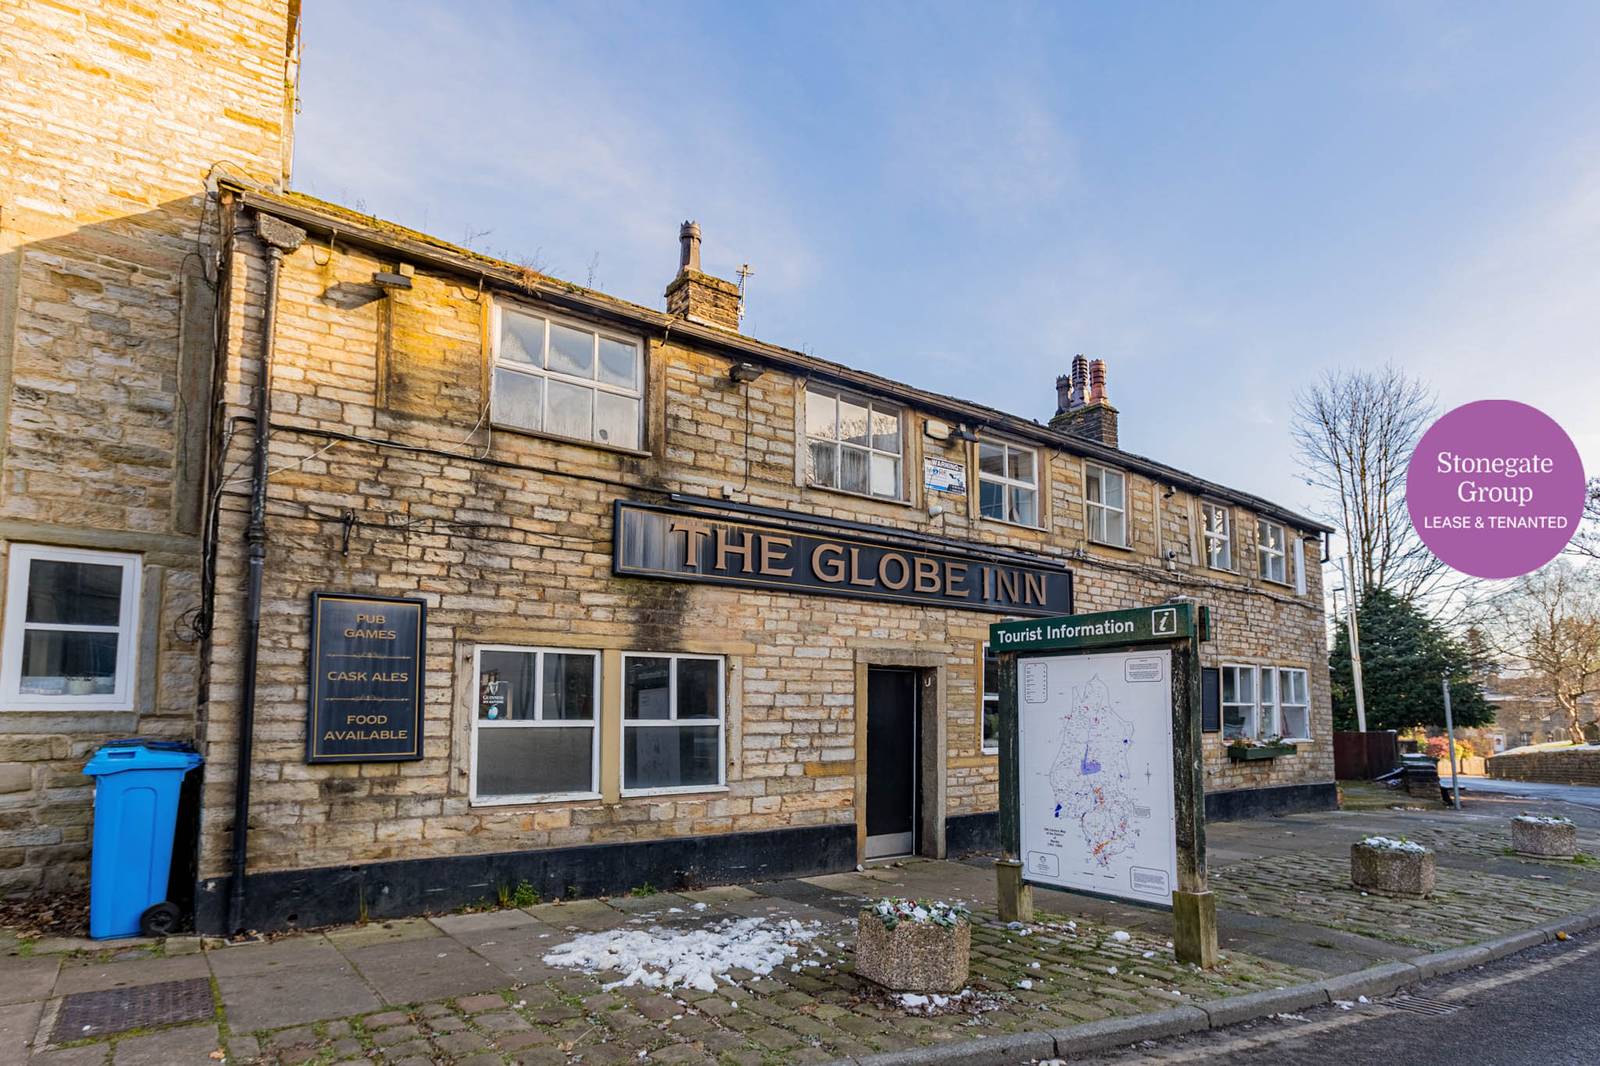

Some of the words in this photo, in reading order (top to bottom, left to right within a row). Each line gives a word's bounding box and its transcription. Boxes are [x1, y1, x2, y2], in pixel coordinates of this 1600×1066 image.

[670, 521, 794, 577] THE
[810, 542, 970, 597] GLOBE
[982, 565, 1048, 606] INN
[356, 614, 386, 624] PUB
[344, 629, 397, 640] GAMES
[997, 628, 1043, 644] Tourist
[1047, 620, 1135, 640] Information
[327, 671, 368, 682] CASK
[371, 672, 409, 682] ALES
[346, 714, 388, 725] FOOD
[323, 730, 408, 741] AVAILABLE
